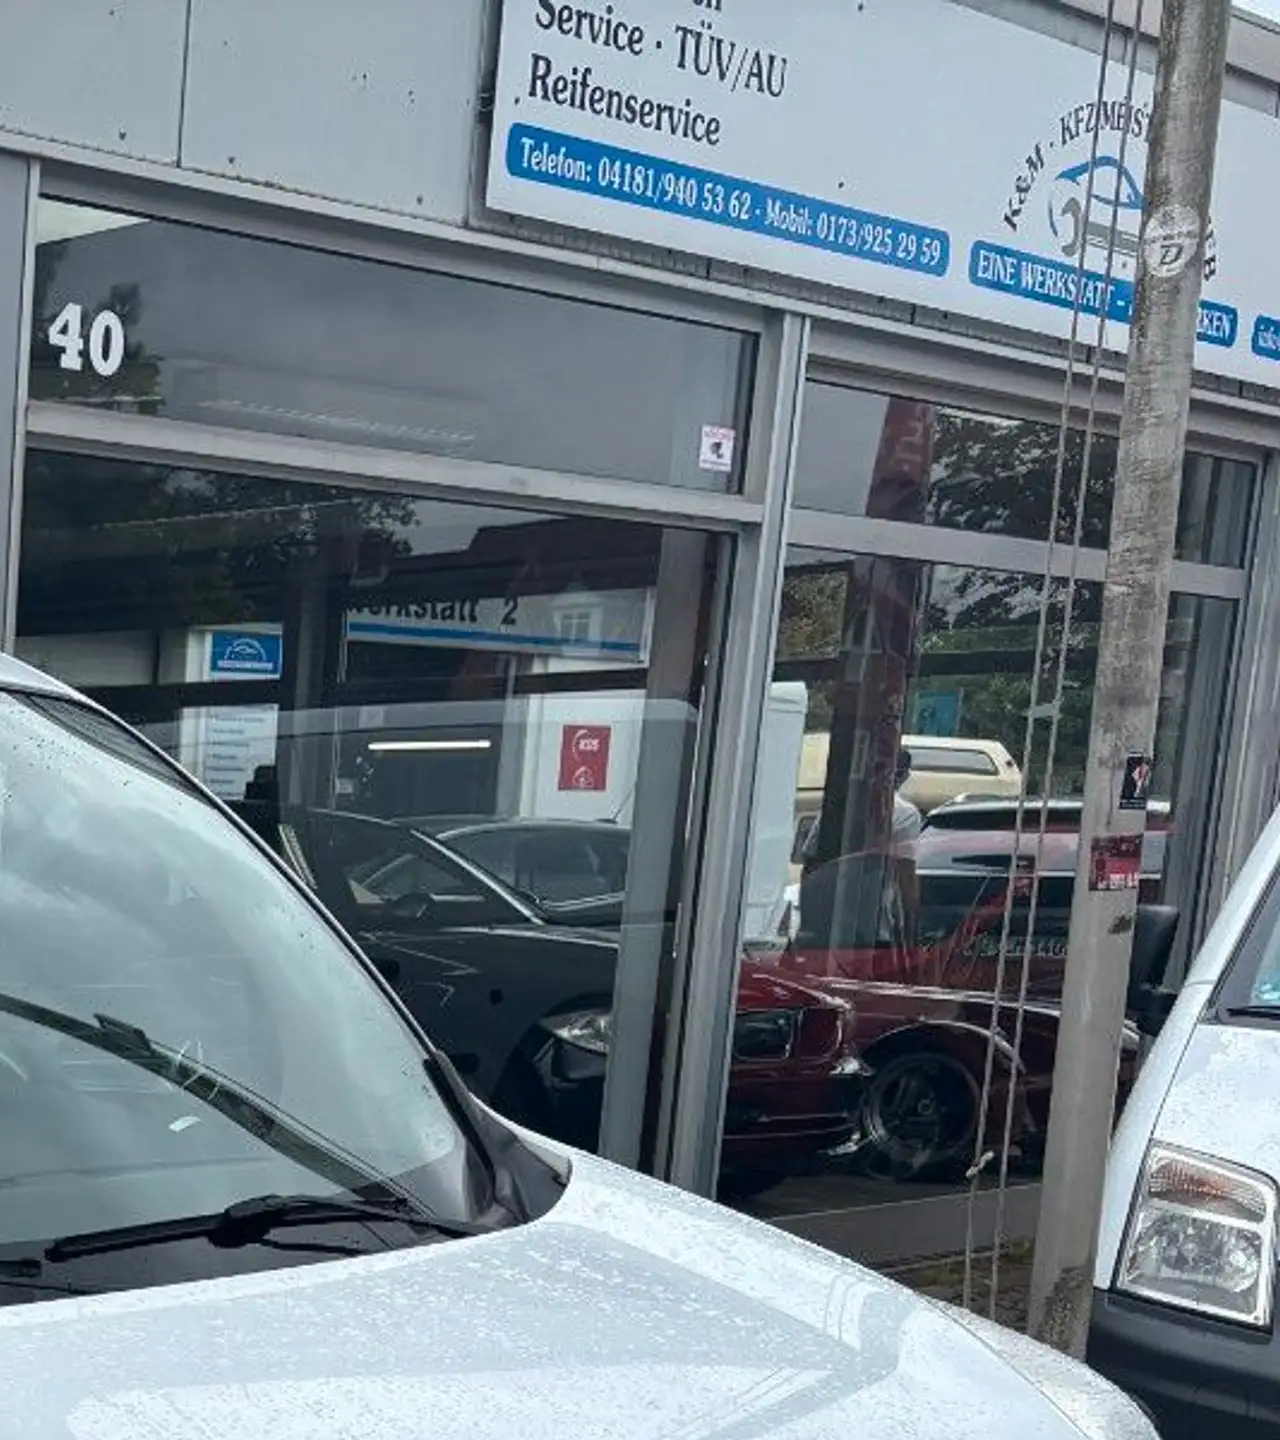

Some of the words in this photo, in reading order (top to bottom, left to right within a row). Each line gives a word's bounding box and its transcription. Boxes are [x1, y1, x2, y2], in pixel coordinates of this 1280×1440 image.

[535, 0, 645, 57] Service
[675, 19, 788, 98] TÜV/AU
[528, 52, 722, 146] Reifenservice
[520, 136, 593, 183] Telefon:
[597, 156, 698, 209] 04181/940
[701, 182, 725, 214] 53
[728, 189, 752, 221] 62
[763, 196, 813, 237] Mobil:
[816, 211, 893, 253] 0173/925
[897, 232, 917, 261] 29
[920, 238, 941, 266] 59
[977, 249, 1017, 286] EINE
[1020, 261, 1116, 312] WERKSTATT
[47, 301, 125, 377] 40
